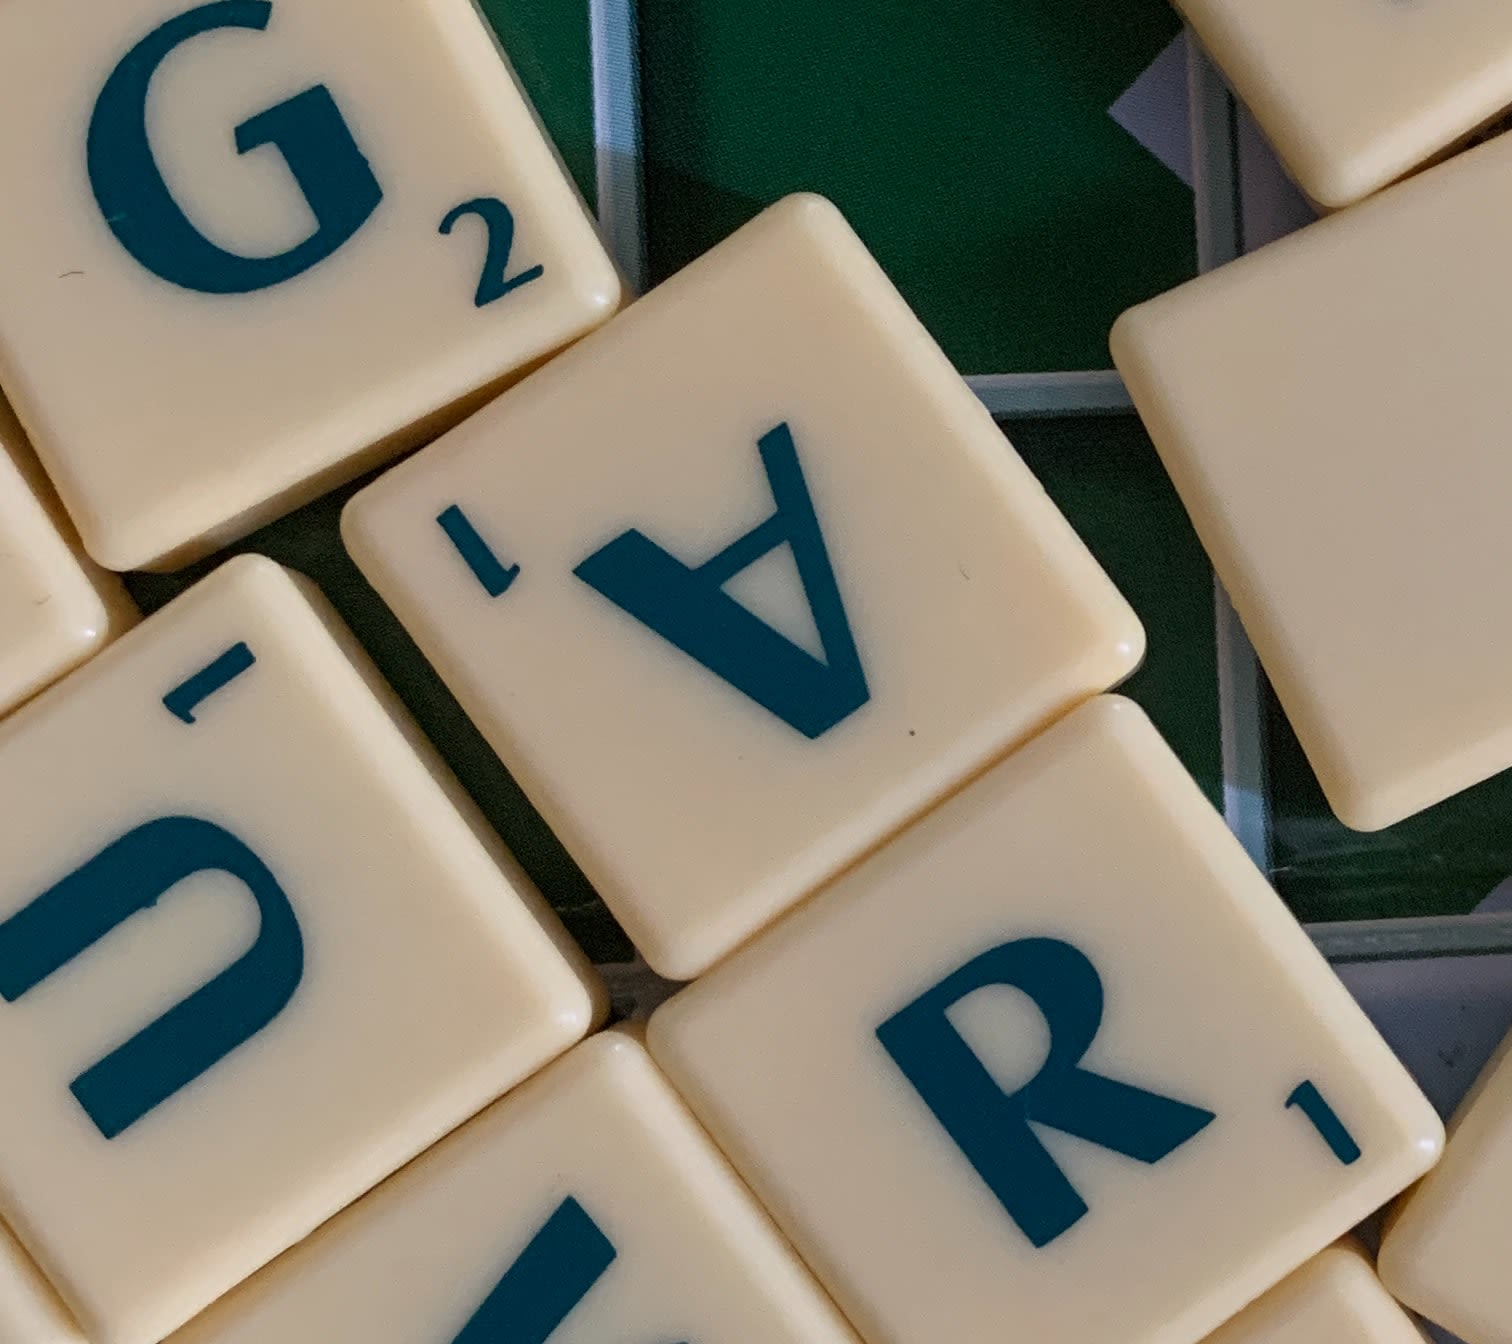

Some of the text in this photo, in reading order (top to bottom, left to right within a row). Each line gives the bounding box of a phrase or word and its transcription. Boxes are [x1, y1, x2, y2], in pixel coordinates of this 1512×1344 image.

[87, 0, 383, 294] G
[439, 197, 543, 307] 2
[437, 505, 520, 597] 1
[574, 423, 870, 739] A
[163, 642, 255, 724] 1
[0, 816, 304, 1139] U
[876, 937, 1214, 1248] R
[1286, 1080, 1361, 1165] 1
